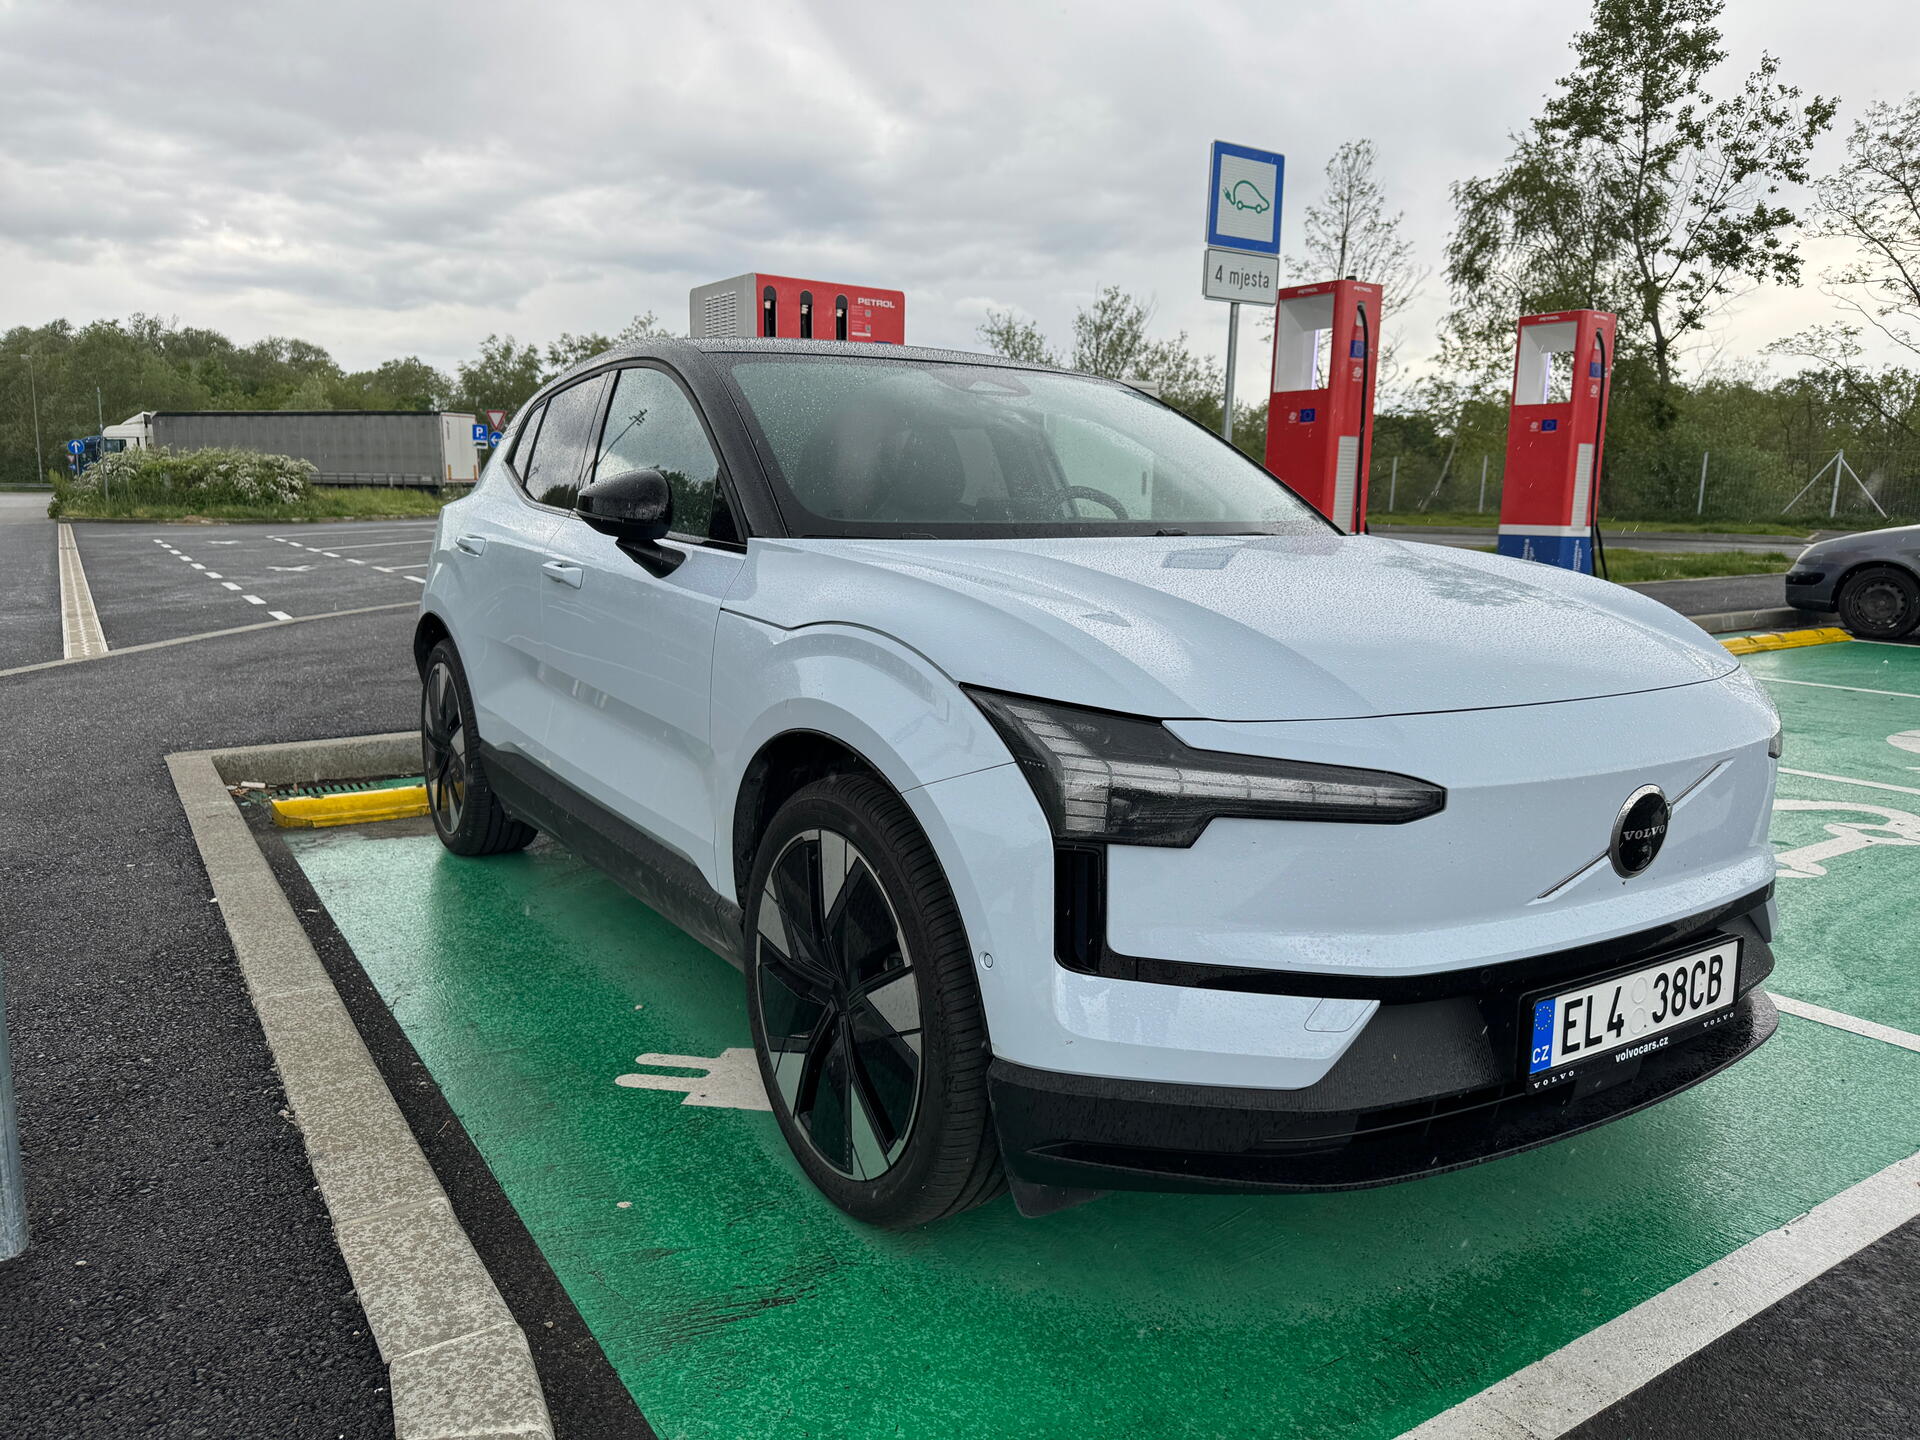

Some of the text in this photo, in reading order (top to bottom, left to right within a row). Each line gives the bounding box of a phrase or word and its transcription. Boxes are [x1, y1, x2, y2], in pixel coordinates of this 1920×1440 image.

[1215, 264, 1270, 290] 4 mjesta
[857, 297, 895, 309] PETROL
[476, 427, 483, 438] P
[1622, 824, 1665, 841] VOLVO
[1561, 954, 1724, 1056] EL4 38CB
[1703, 1011, 1735, 1028] VOLVO
[1532, 1044, 1549, 1065] CZ
[1615, 1036, 1669, 1063] volvocars.cz
[1533, 1070, 1575, 1089] VOLVO
